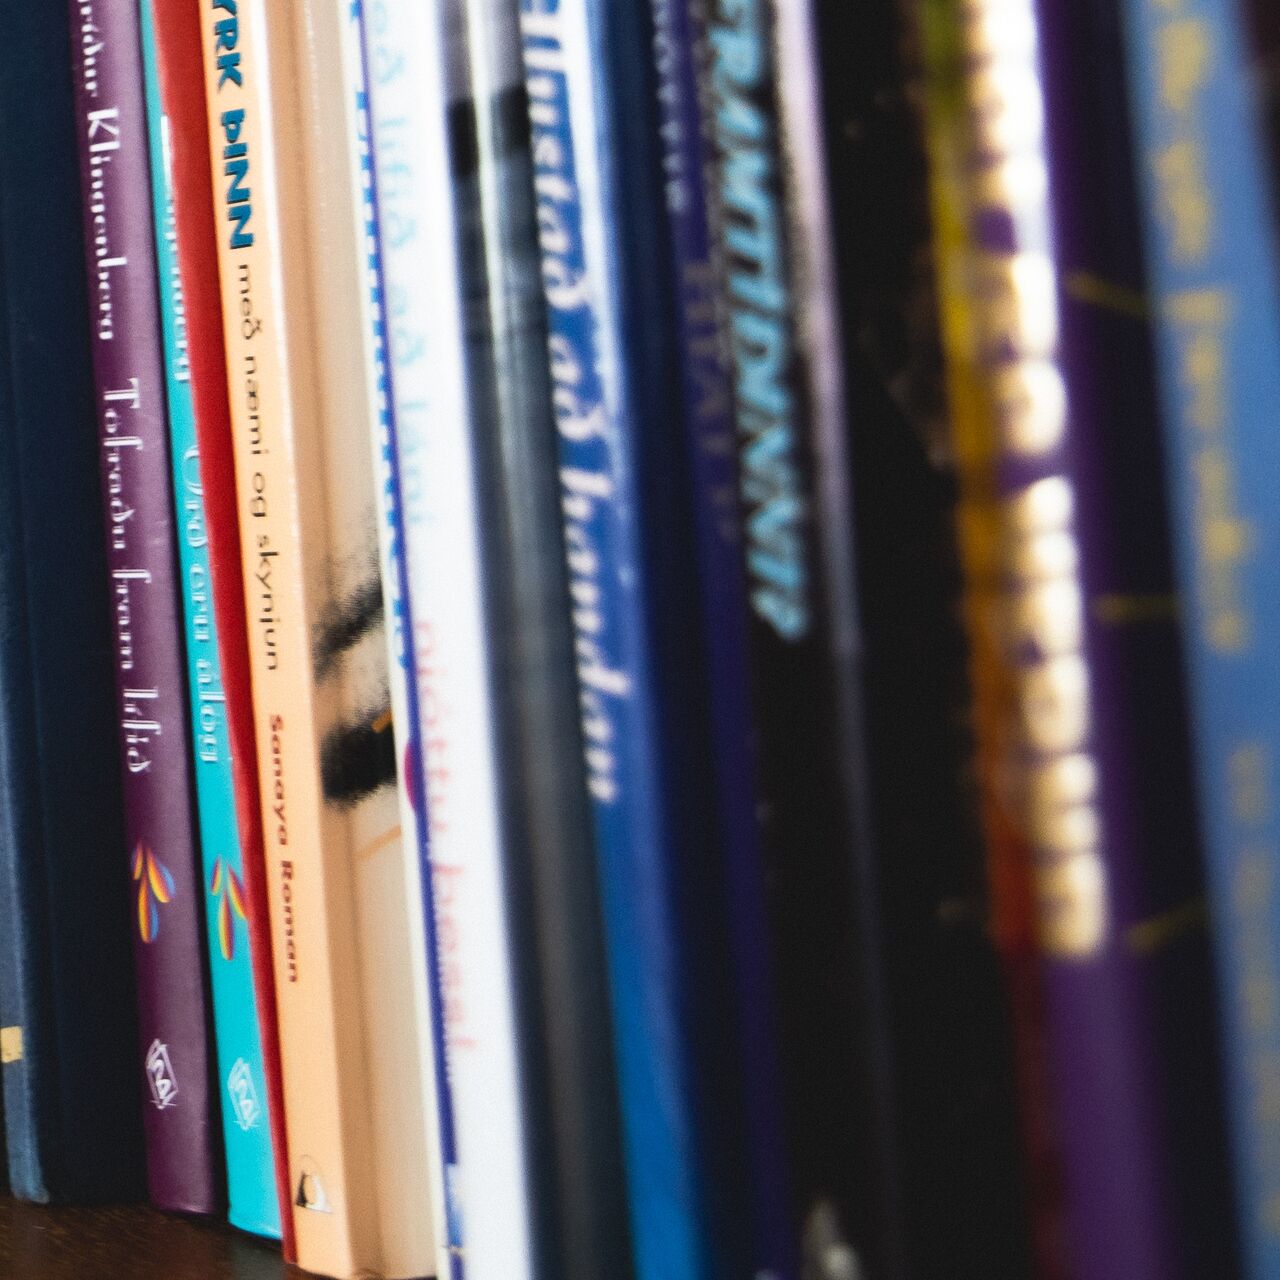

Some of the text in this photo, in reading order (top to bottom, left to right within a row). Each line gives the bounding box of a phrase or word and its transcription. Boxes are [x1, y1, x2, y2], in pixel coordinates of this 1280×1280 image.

[85, 107, 130, 341] Klingenberg
[221, 108, 255, 252] ÞINN
[238, 265, 261, 339] með
[244, 355, 270, 455] næmi
[550, 335, 611, 444] að
[250, 470, 267, 518] og
[112, 567, 152, 671] fram
[190, 561, 210, 643] eru
[256, 533, 280, 672] skynjun
[561, 463, 631, 805] handan
[269, 713, 300, 984] Sanaya Roman
